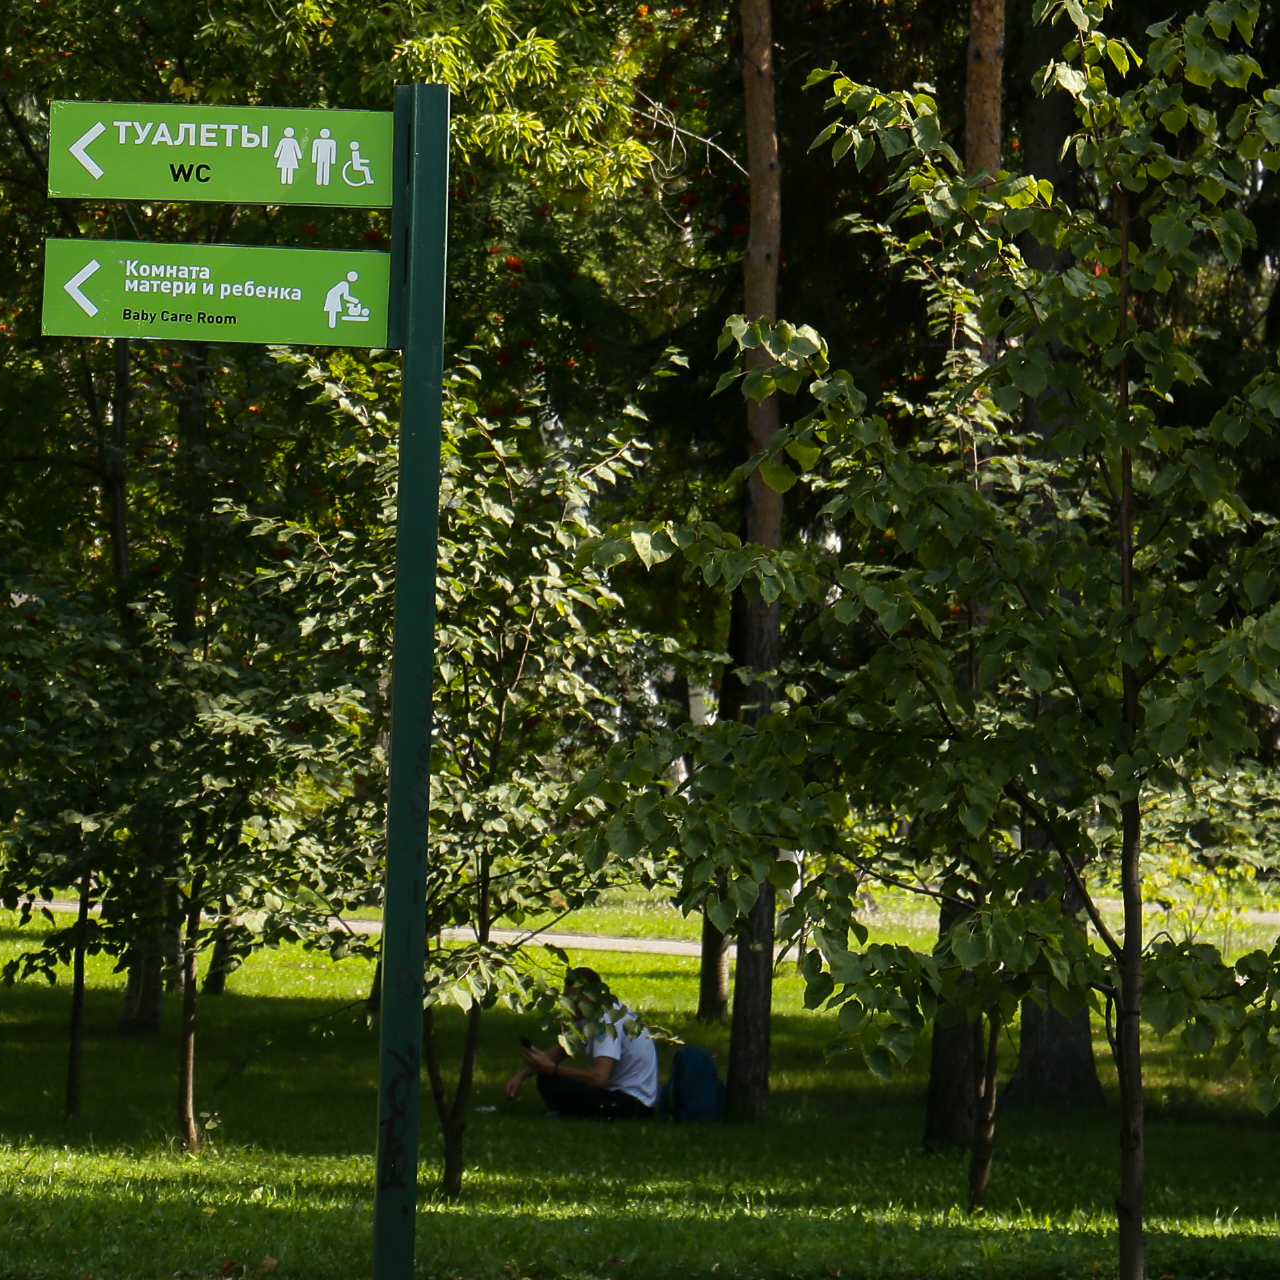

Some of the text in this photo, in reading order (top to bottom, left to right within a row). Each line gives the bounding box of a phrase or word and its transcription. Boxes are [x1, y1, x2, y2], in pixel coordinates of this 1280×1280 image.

[113, 121, 269, 148] ТУАЛЕТЫ
[169, 163, 212, 183] WC
[125, 260, 211, 280] Комната
[124, 279, 303, 301] матери и ребенка
[122, 308, 237, 325] Baby Care Room
